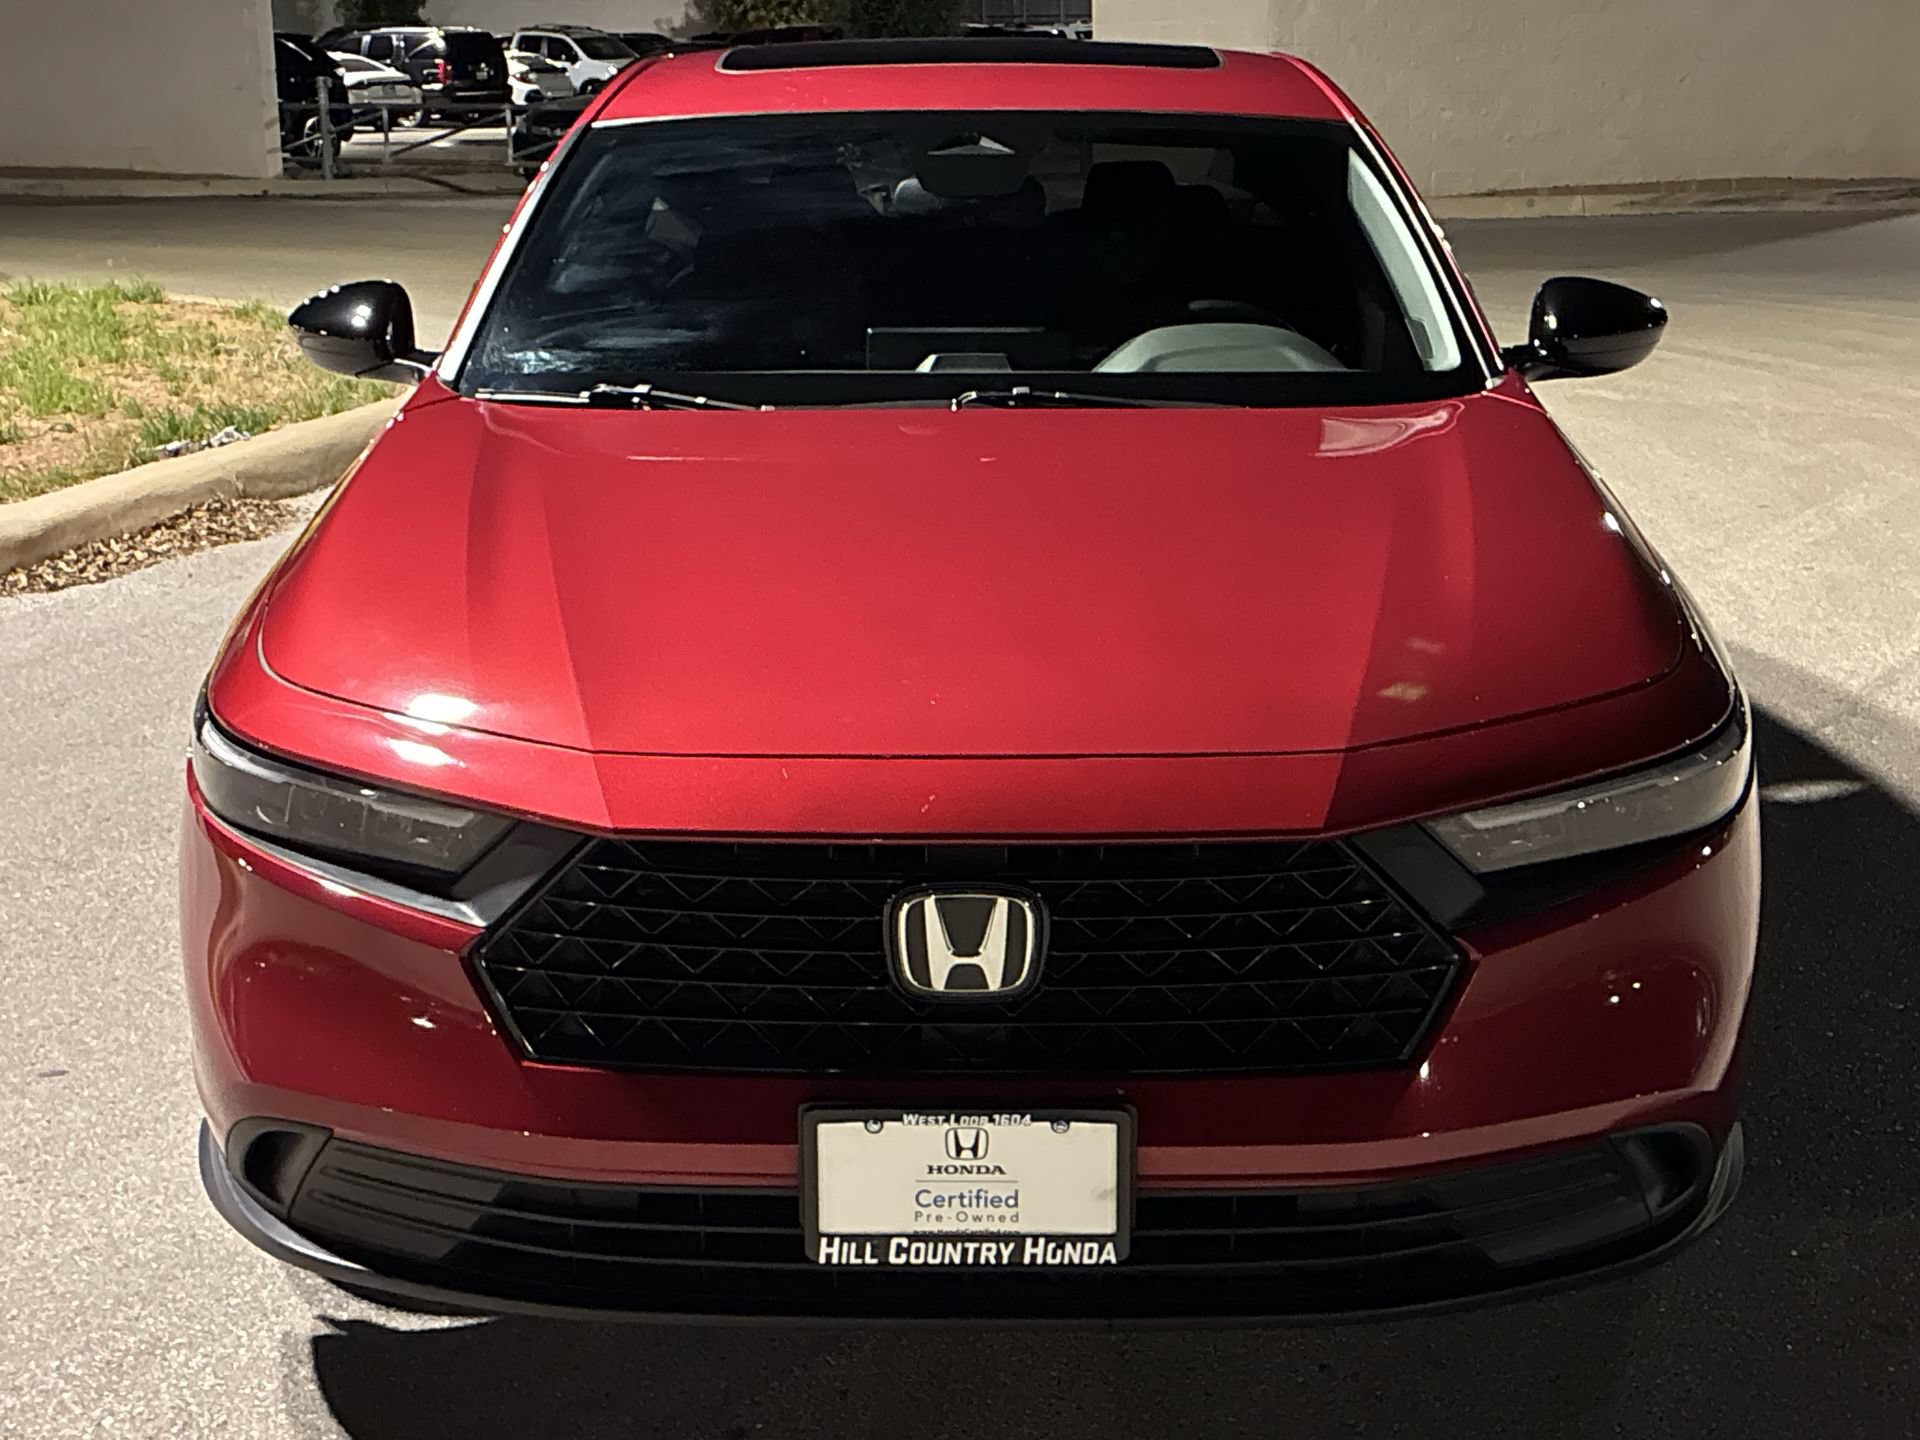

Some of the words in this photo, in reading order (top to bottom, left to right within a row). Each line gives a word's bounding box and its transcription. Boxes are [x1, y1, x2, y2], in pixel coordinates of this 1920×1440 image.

[992, 1114, 1032, 1127] 1604
[926, 1164, 1007, 1175] HONDA
[915, 1188, 1019, 1209] Certified
[914, 1210, 1019, 1223] Pre-Owned
[818, 1236, 879, 1265] HILL
[888, 1236, 1015, 1265] COUNTRY
[1023, 1236, 1117, 1265] HONDA
